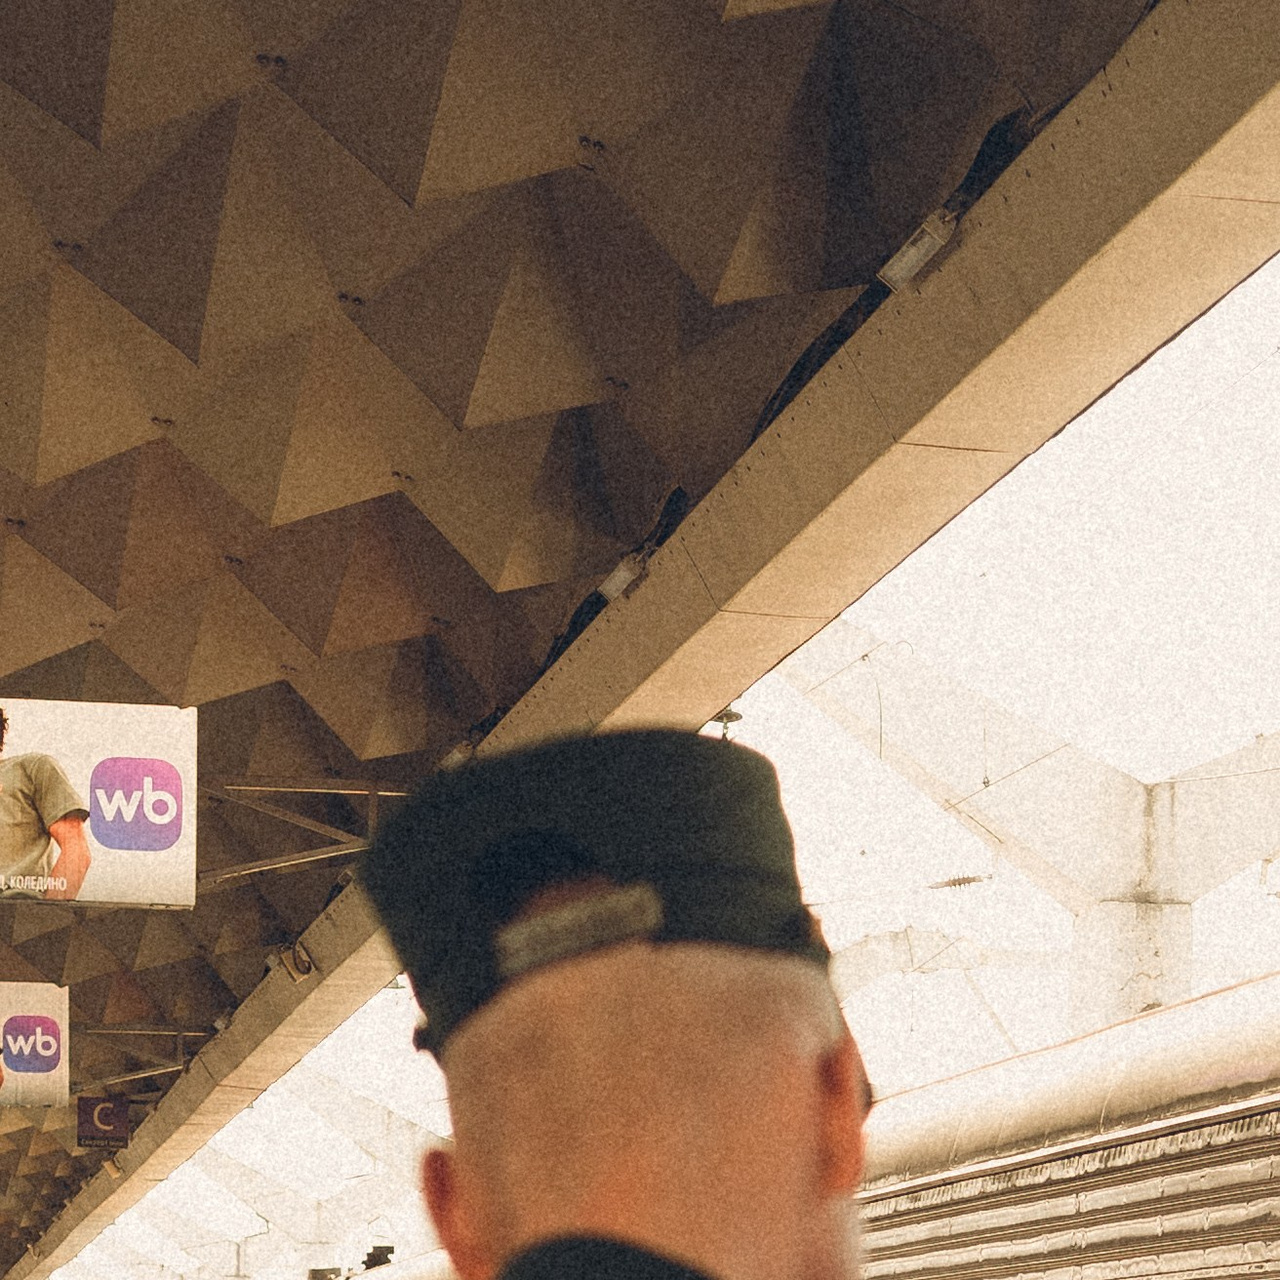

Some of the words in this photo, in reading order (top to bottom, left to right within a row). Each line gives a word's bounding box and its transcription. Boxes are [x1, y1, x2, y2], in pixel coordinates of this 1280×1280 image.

[95, 776, 178, 825] wb
[10, 875, 67, 892] КОЛЕДИНО
[5, 1026, 58, 1057] wb
